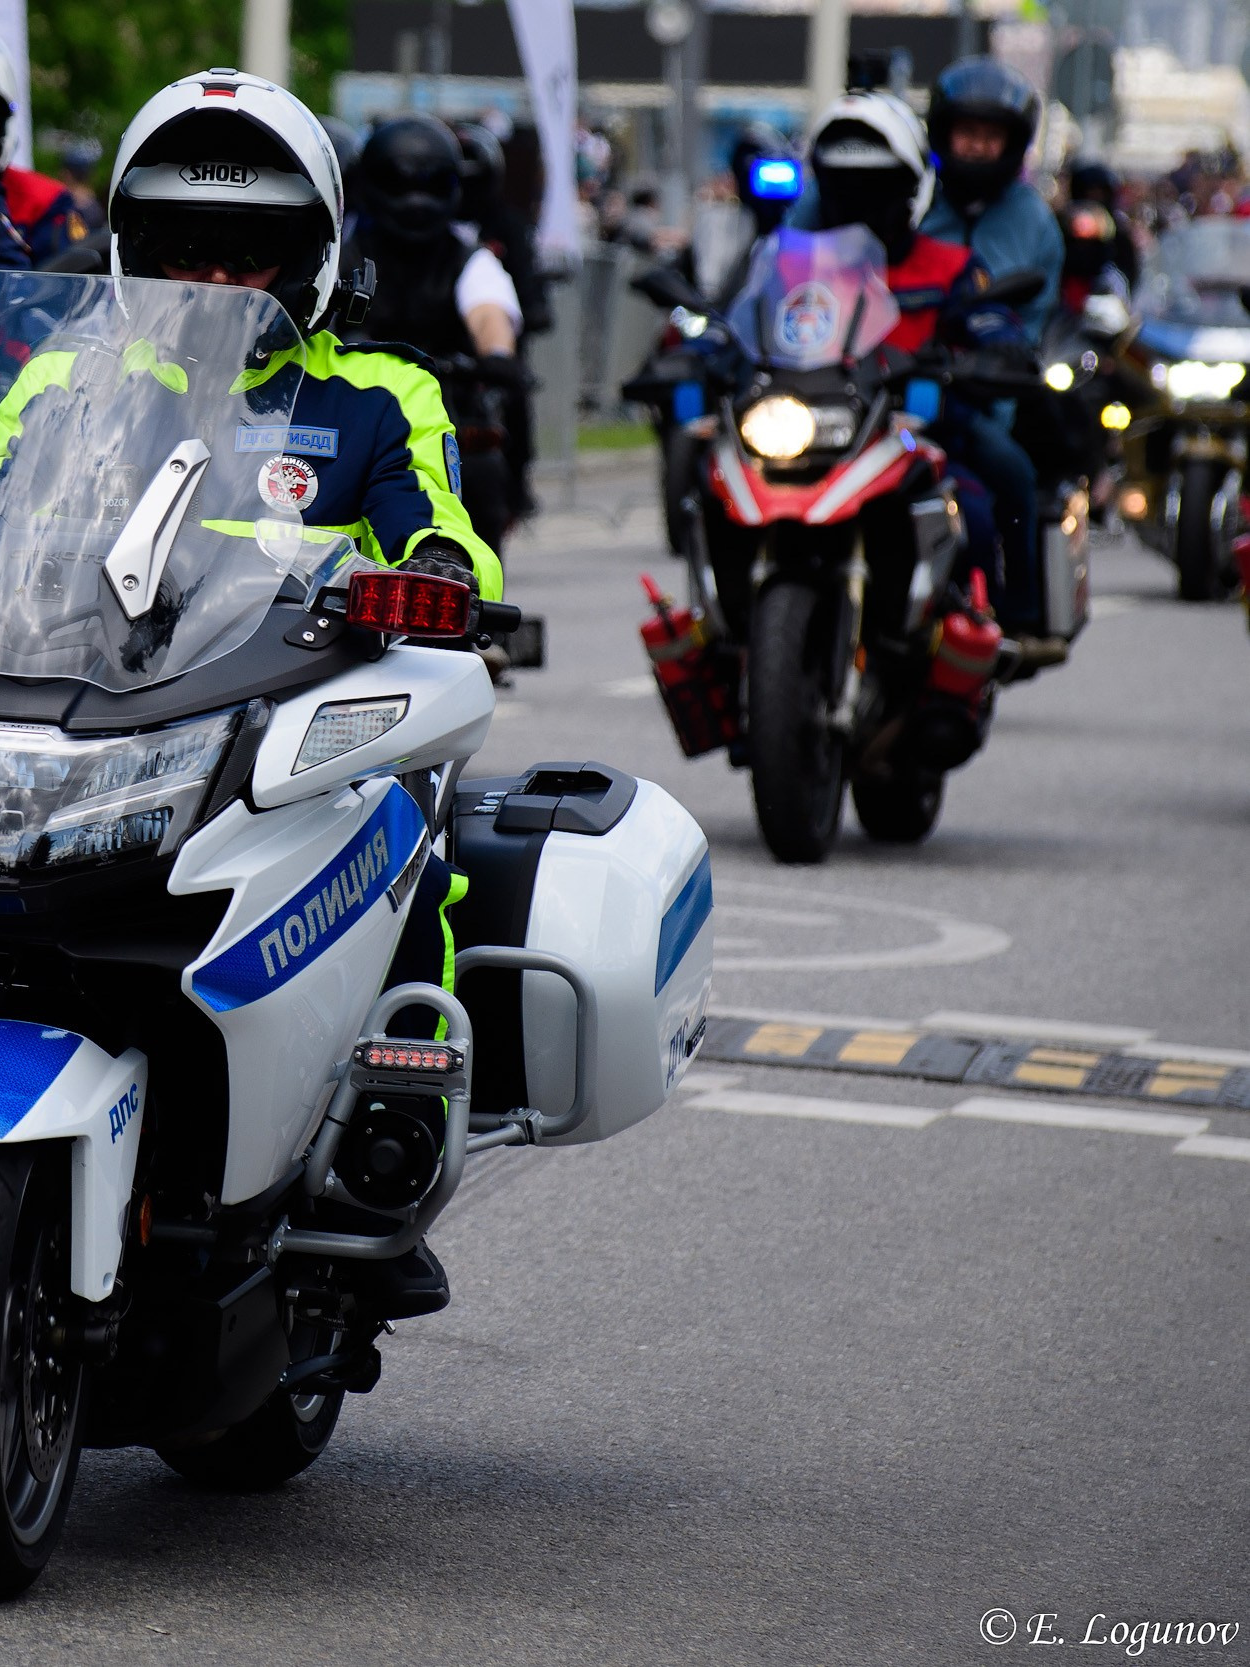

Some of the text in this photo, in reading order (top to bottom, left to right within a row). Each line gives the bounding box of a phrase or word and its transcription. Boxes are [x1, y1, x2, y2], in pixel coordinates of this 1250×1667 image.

[190, 163, 248, 184] SHOEI
[244, 432, 331, 451] ДПС ГИБДД
[266, 456, 314, 478] ПОЛИЦИЯ
[104, 498, 130, 507] DOZOR
[258, 826, 390, 979] ПОЛИЦИЯ
[108, 1083, 139, 1145] ДПС
